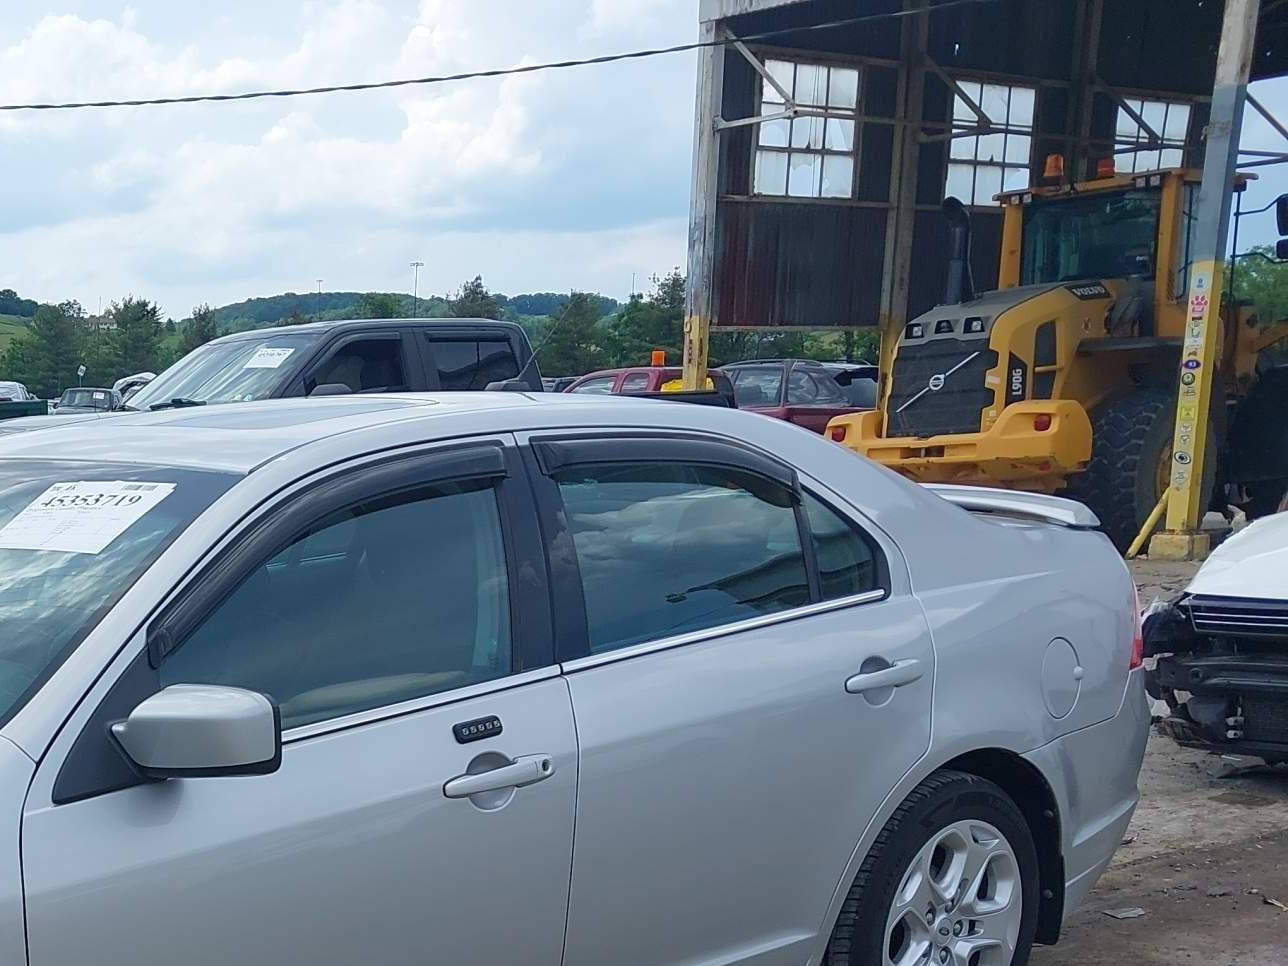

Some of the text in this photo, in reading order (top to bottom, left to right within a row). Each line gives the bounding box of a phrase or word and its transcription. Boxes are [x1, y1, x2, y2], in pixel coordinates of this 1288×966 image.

[1072, 286, 1105, 296] VOLVO
[1012, 368, 1023, 396] L90G
[41, 493, 142, 507] 45353719
